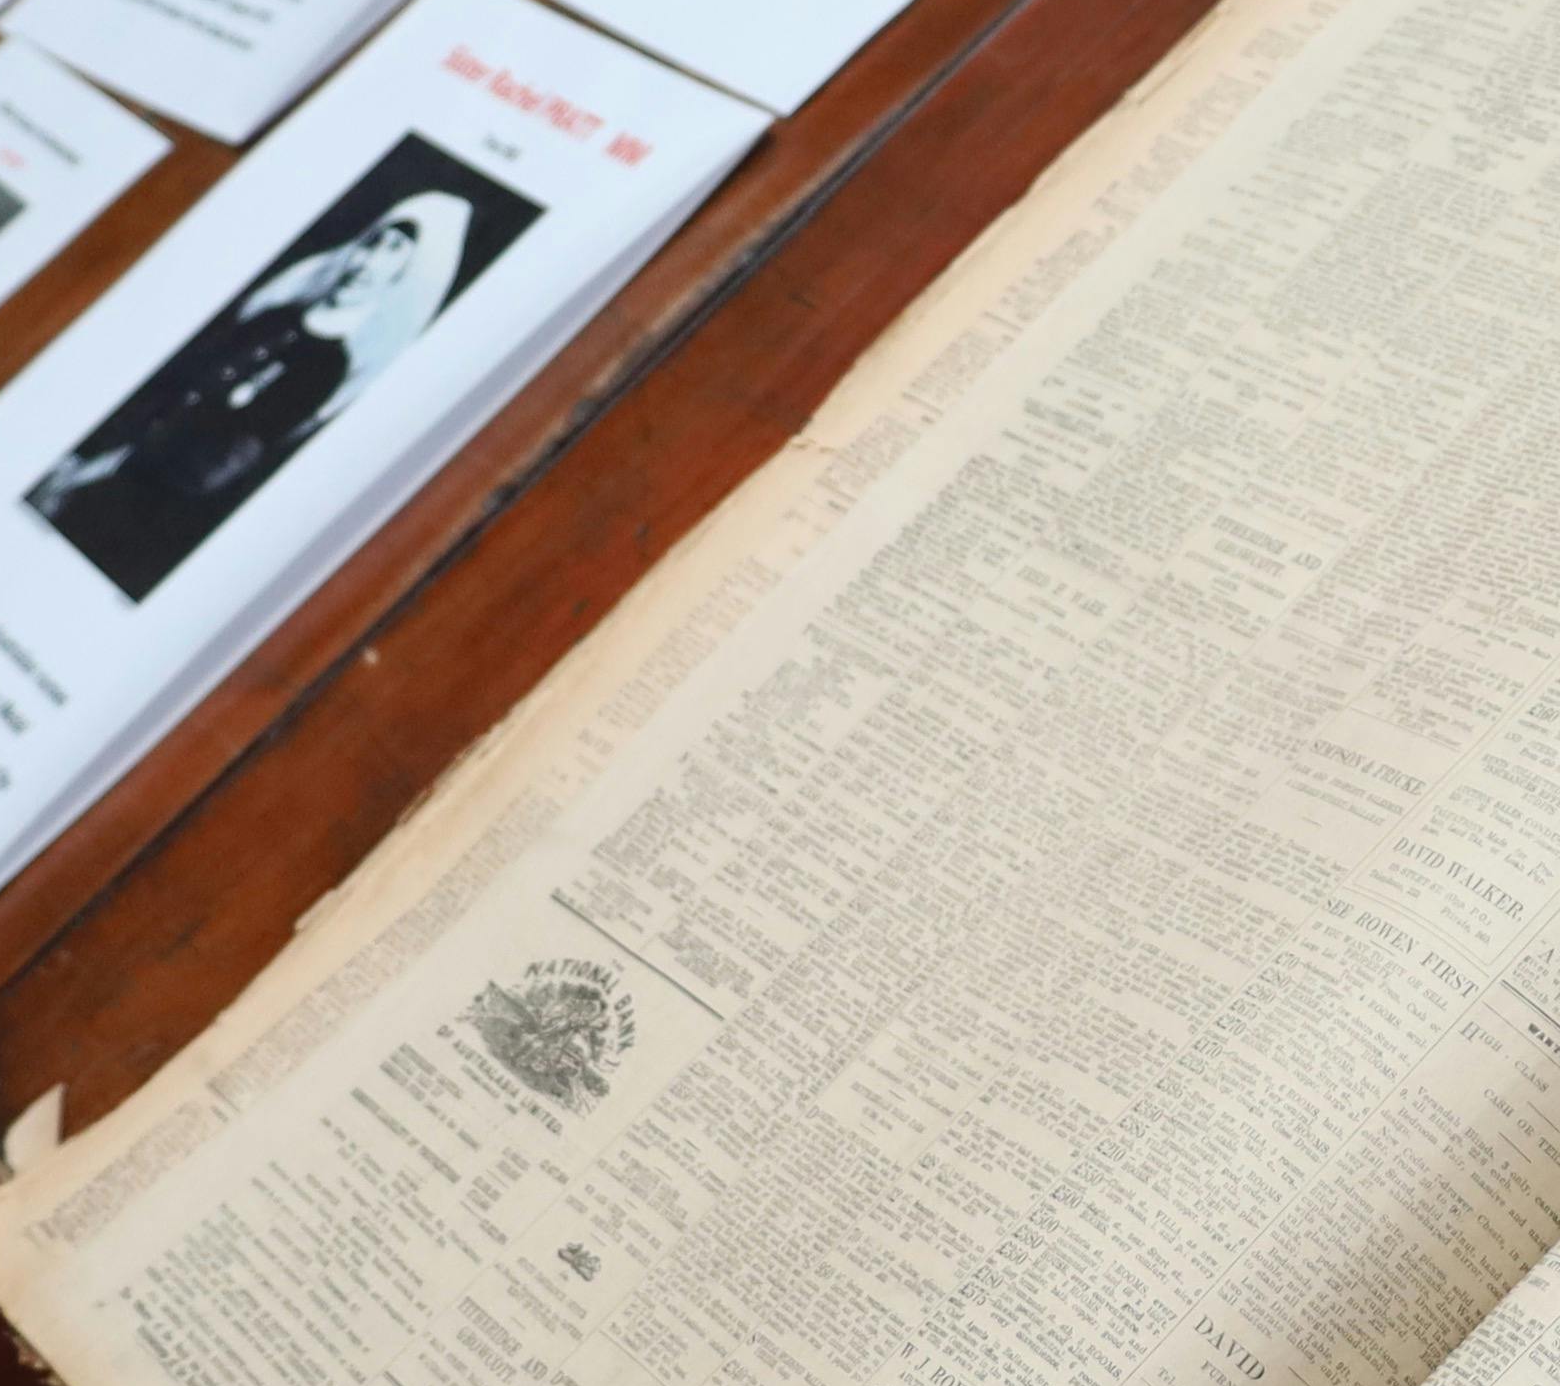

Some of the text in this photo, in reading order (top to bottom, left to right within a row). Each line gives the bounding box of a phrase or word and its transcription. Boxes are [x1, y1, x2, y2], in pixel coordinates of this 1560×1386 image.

[1391, 835, 1447, 870] DAVID
[1326, 897, 1479, 1001] SEE ROWEN FIRST
[1193, 1313, 1267, 1382] DAVID
